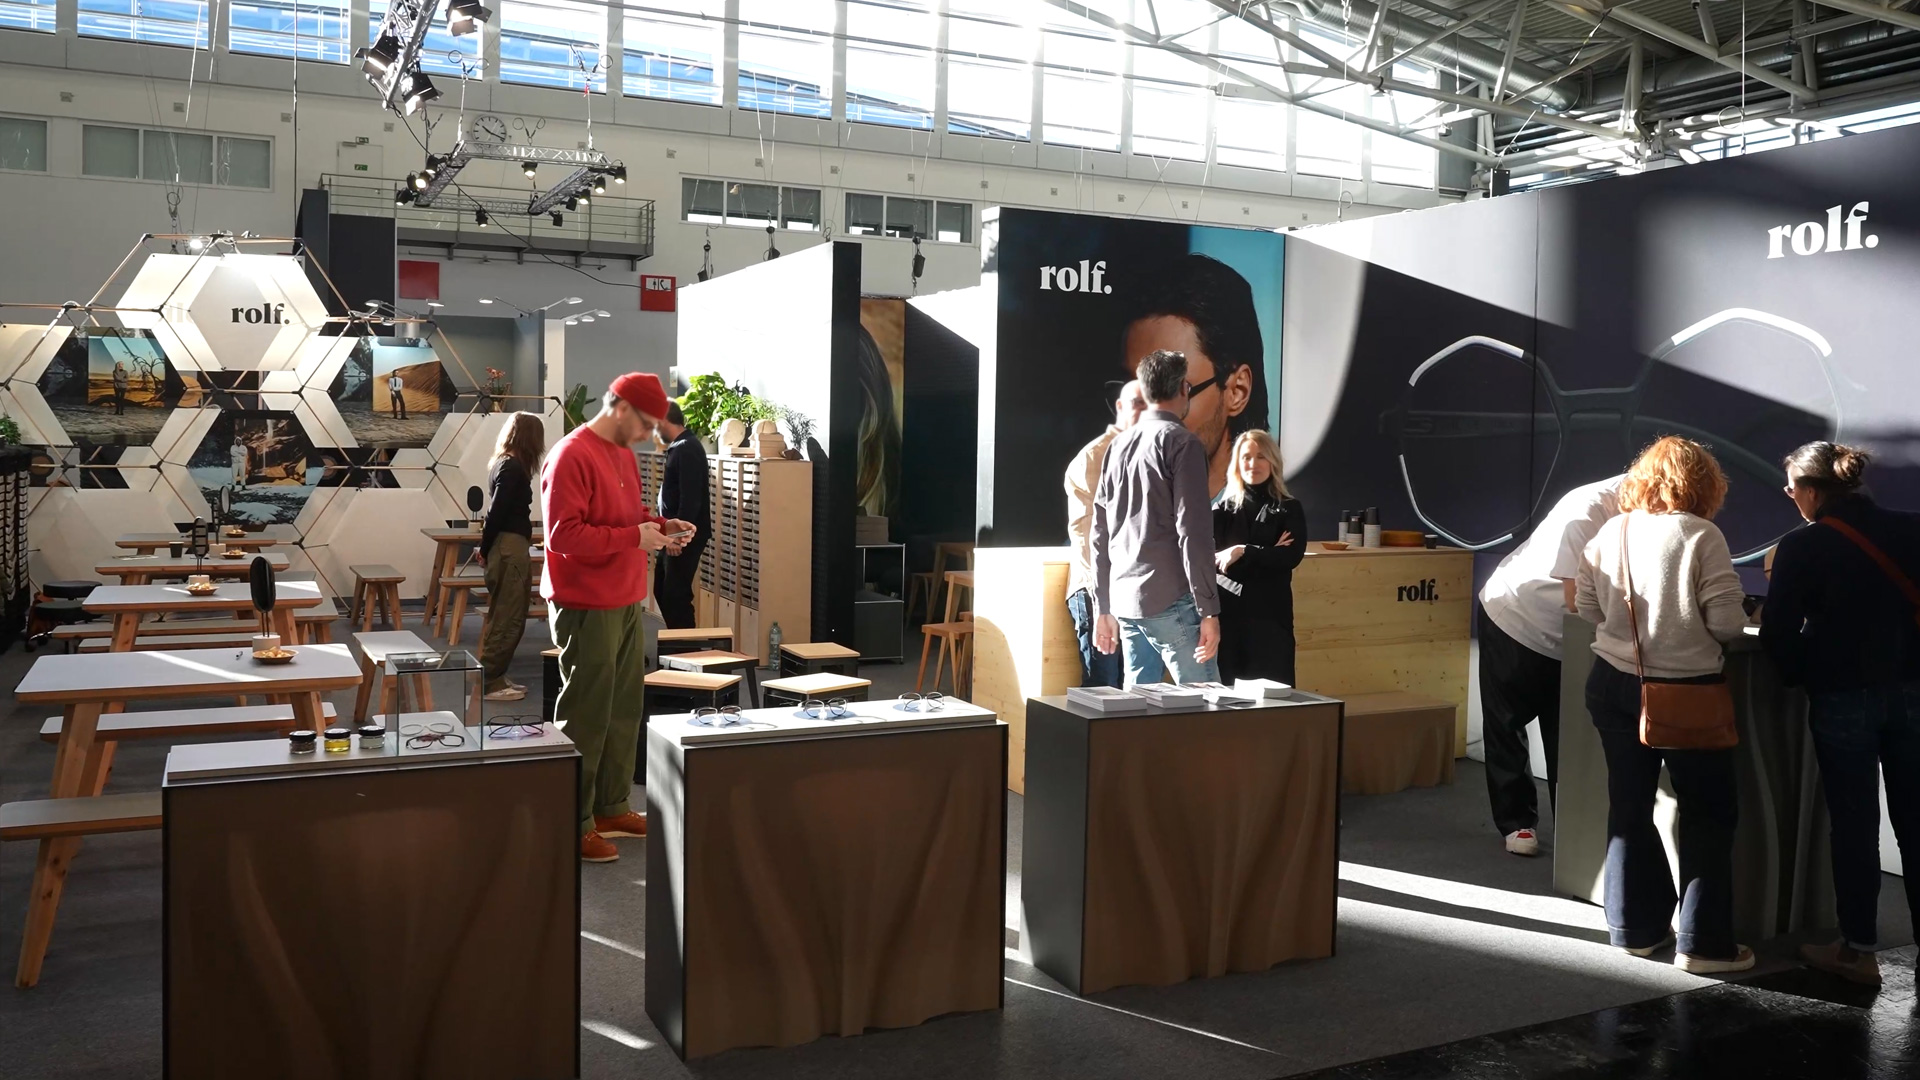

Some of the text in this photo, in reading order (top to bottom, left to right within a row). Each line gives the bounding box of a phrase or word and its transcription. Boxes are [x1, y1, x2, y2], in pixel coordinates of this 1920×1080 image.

[1766, 201, 1879, 259] rolf.
[1039, 260, 1112, 295] rolf.
[231, 303, 290, 325] rolf.
[1397, 578, 1439, 602] rolf.
